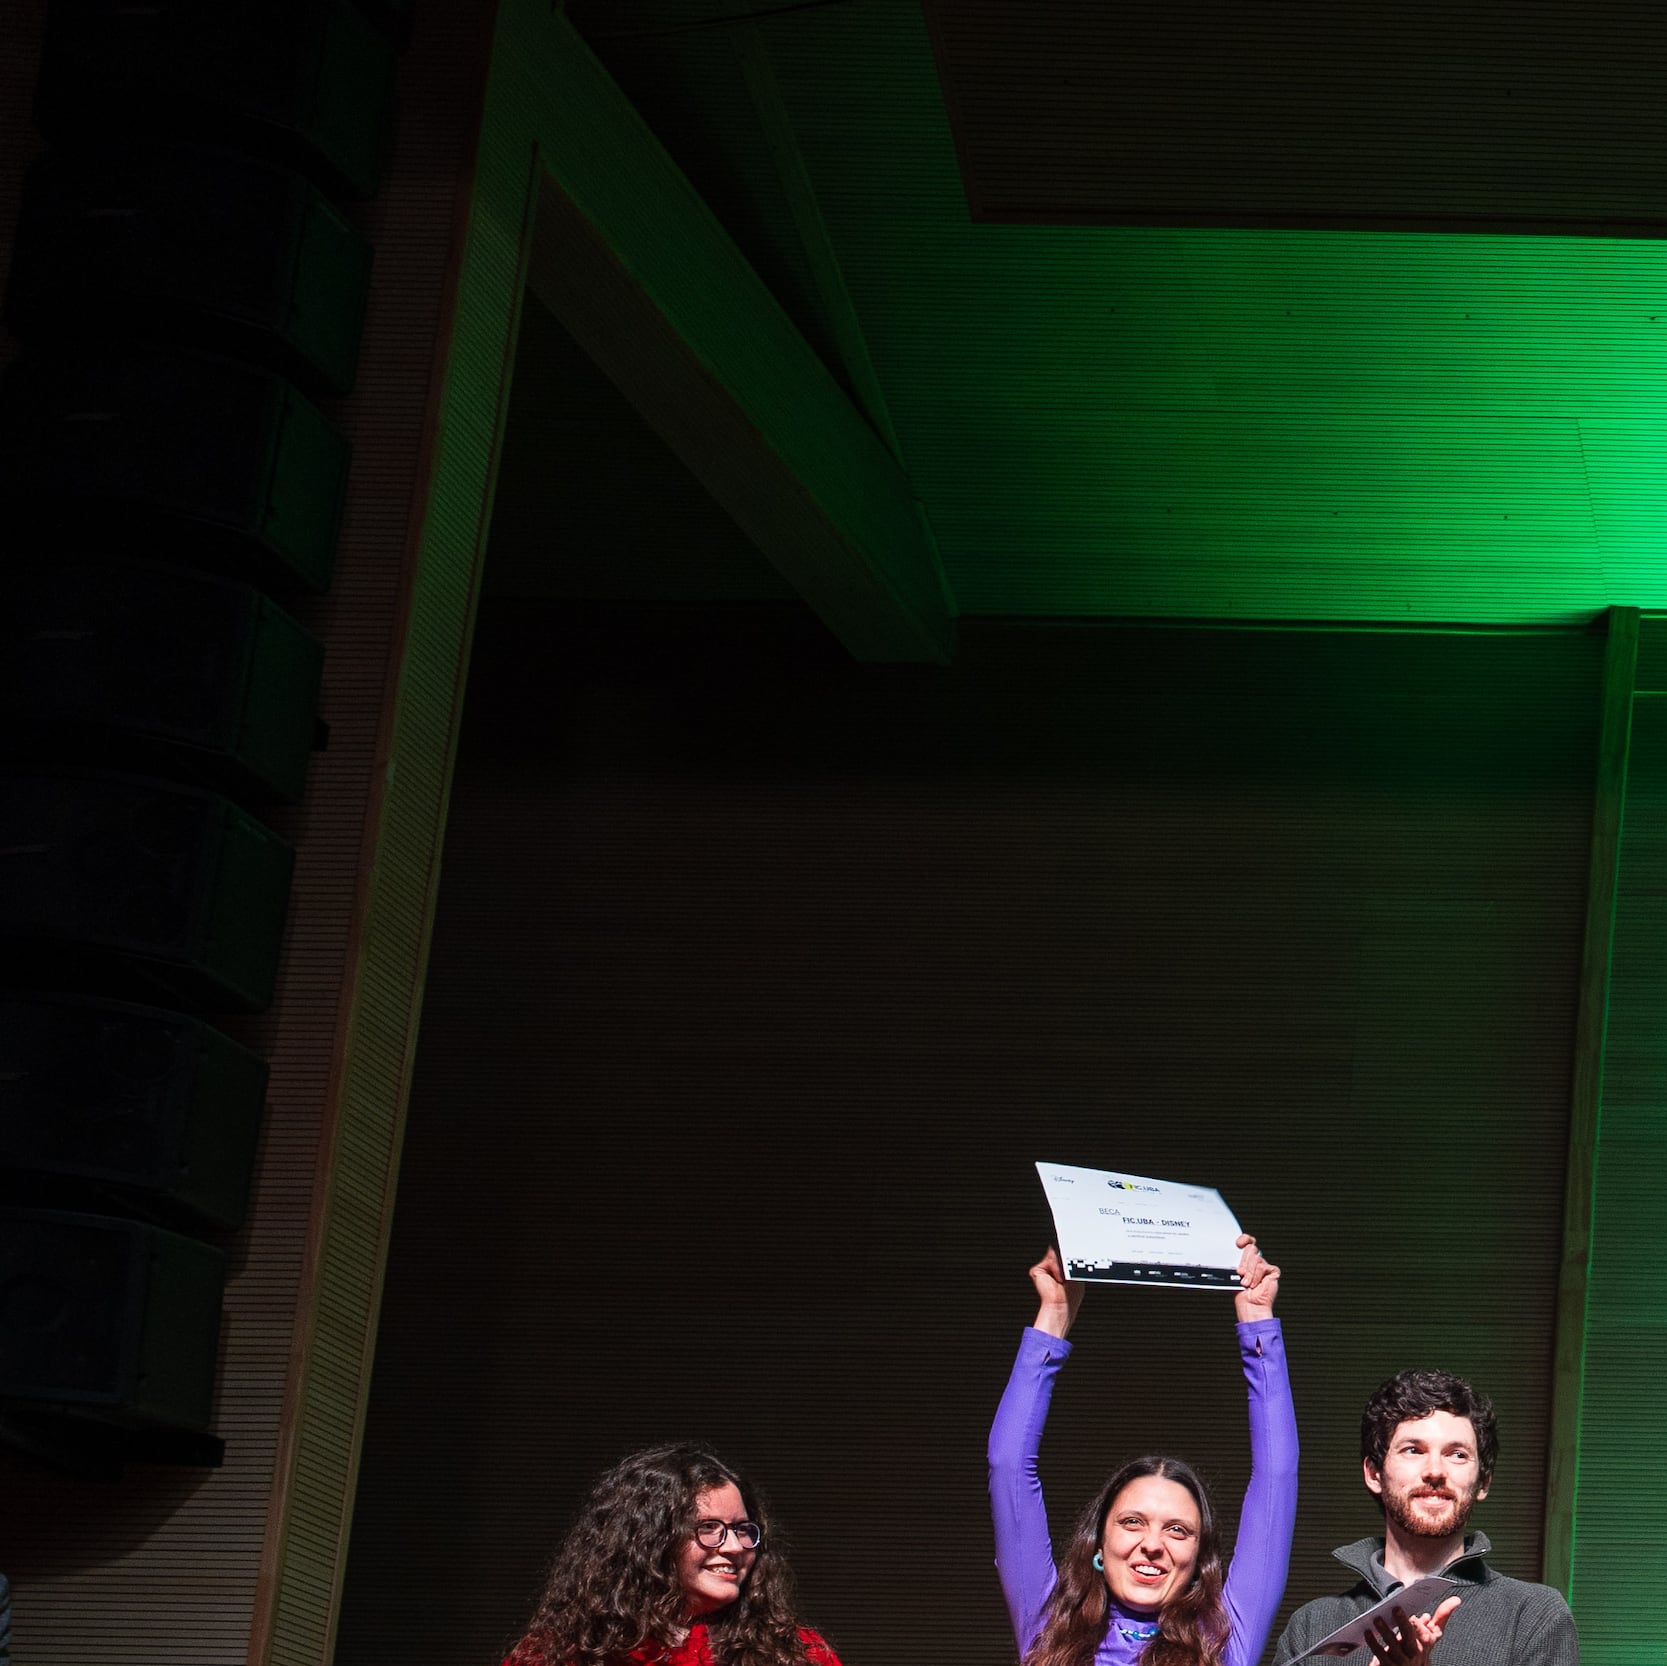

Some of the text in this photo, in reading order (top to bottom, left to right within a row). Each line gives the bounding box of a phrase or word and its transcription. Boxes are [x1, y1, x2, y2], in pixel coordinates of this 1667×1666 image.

[1099, 1207, 1121, 1216] BECA
[1122, 1216, 1154, 1226] FIC.UBA
[1161, 1219, 1191, 1228] DISNEY
